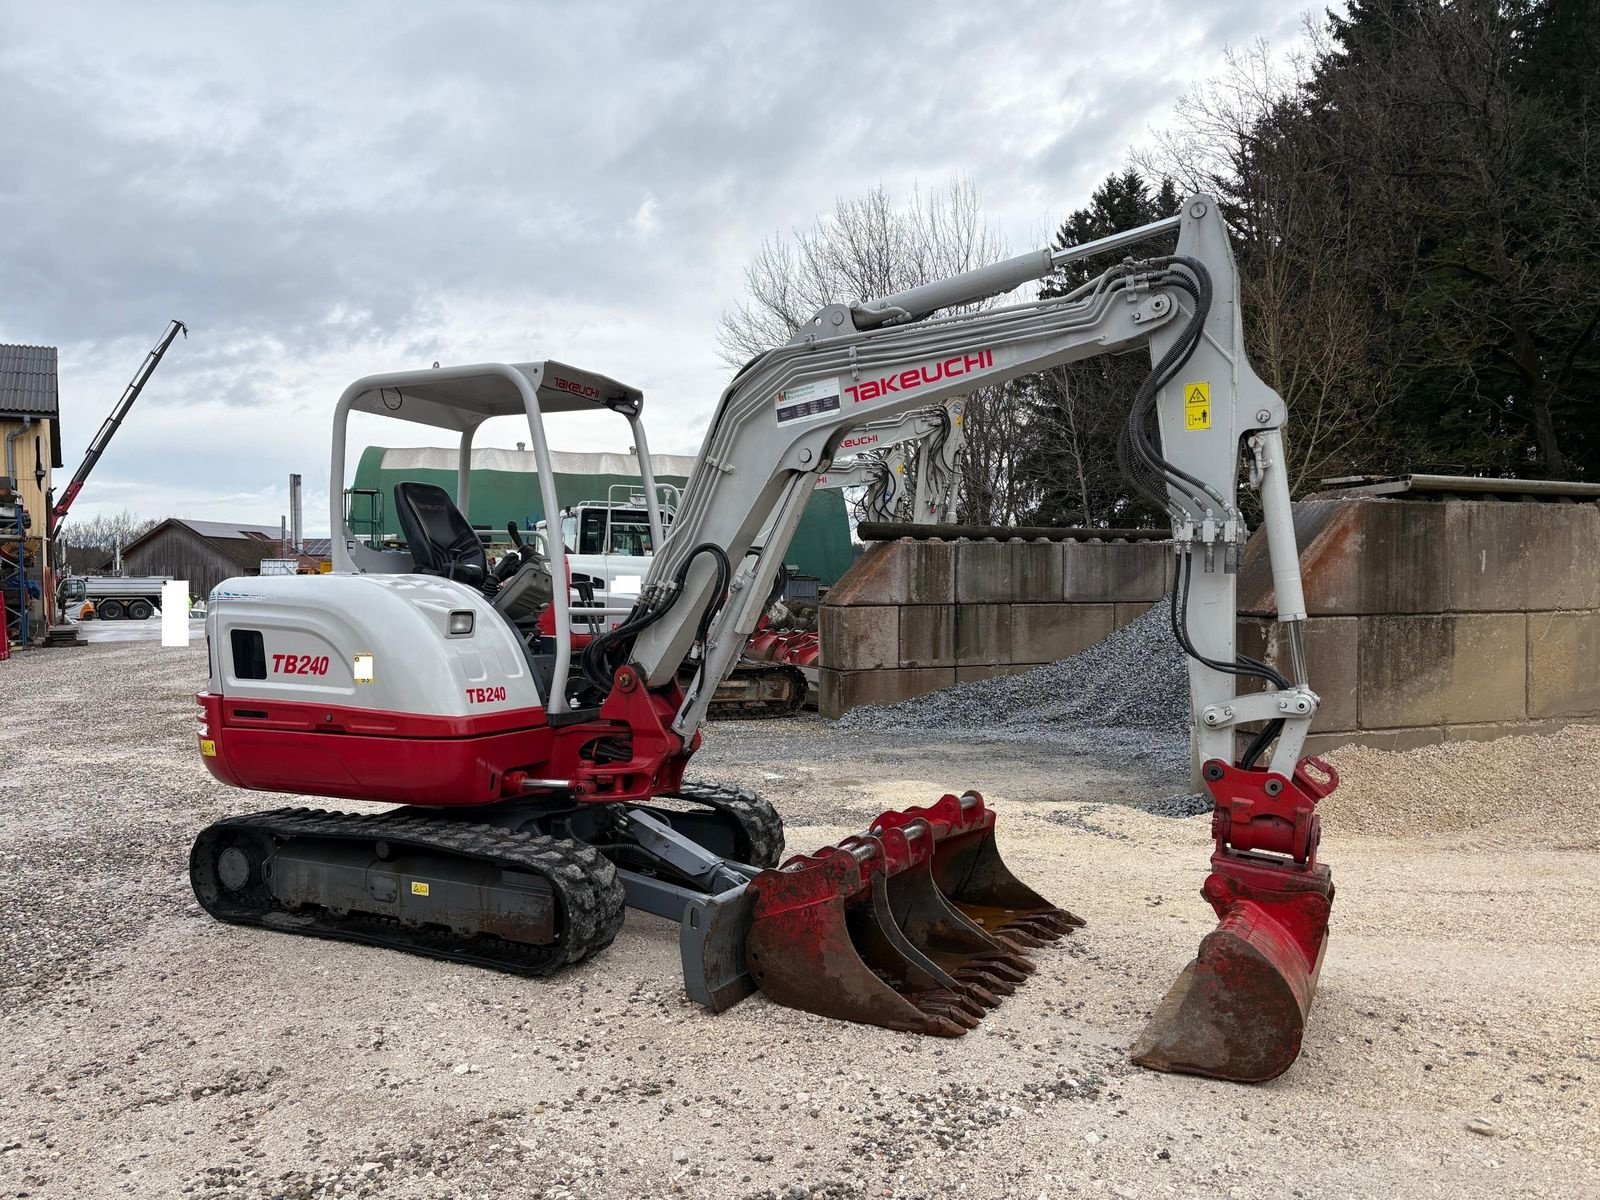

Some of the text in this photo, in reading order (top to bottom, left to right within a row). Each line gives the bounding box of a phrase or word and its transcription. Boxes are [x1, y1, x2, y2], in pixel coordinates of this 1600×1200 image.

[844, 348, 993, 403] TAKEUCHI
[554, 377, 601, 399] TAKEUCHI
[272, 654, 330, 676] TB240
[465, 686, 506, 704] TB240
